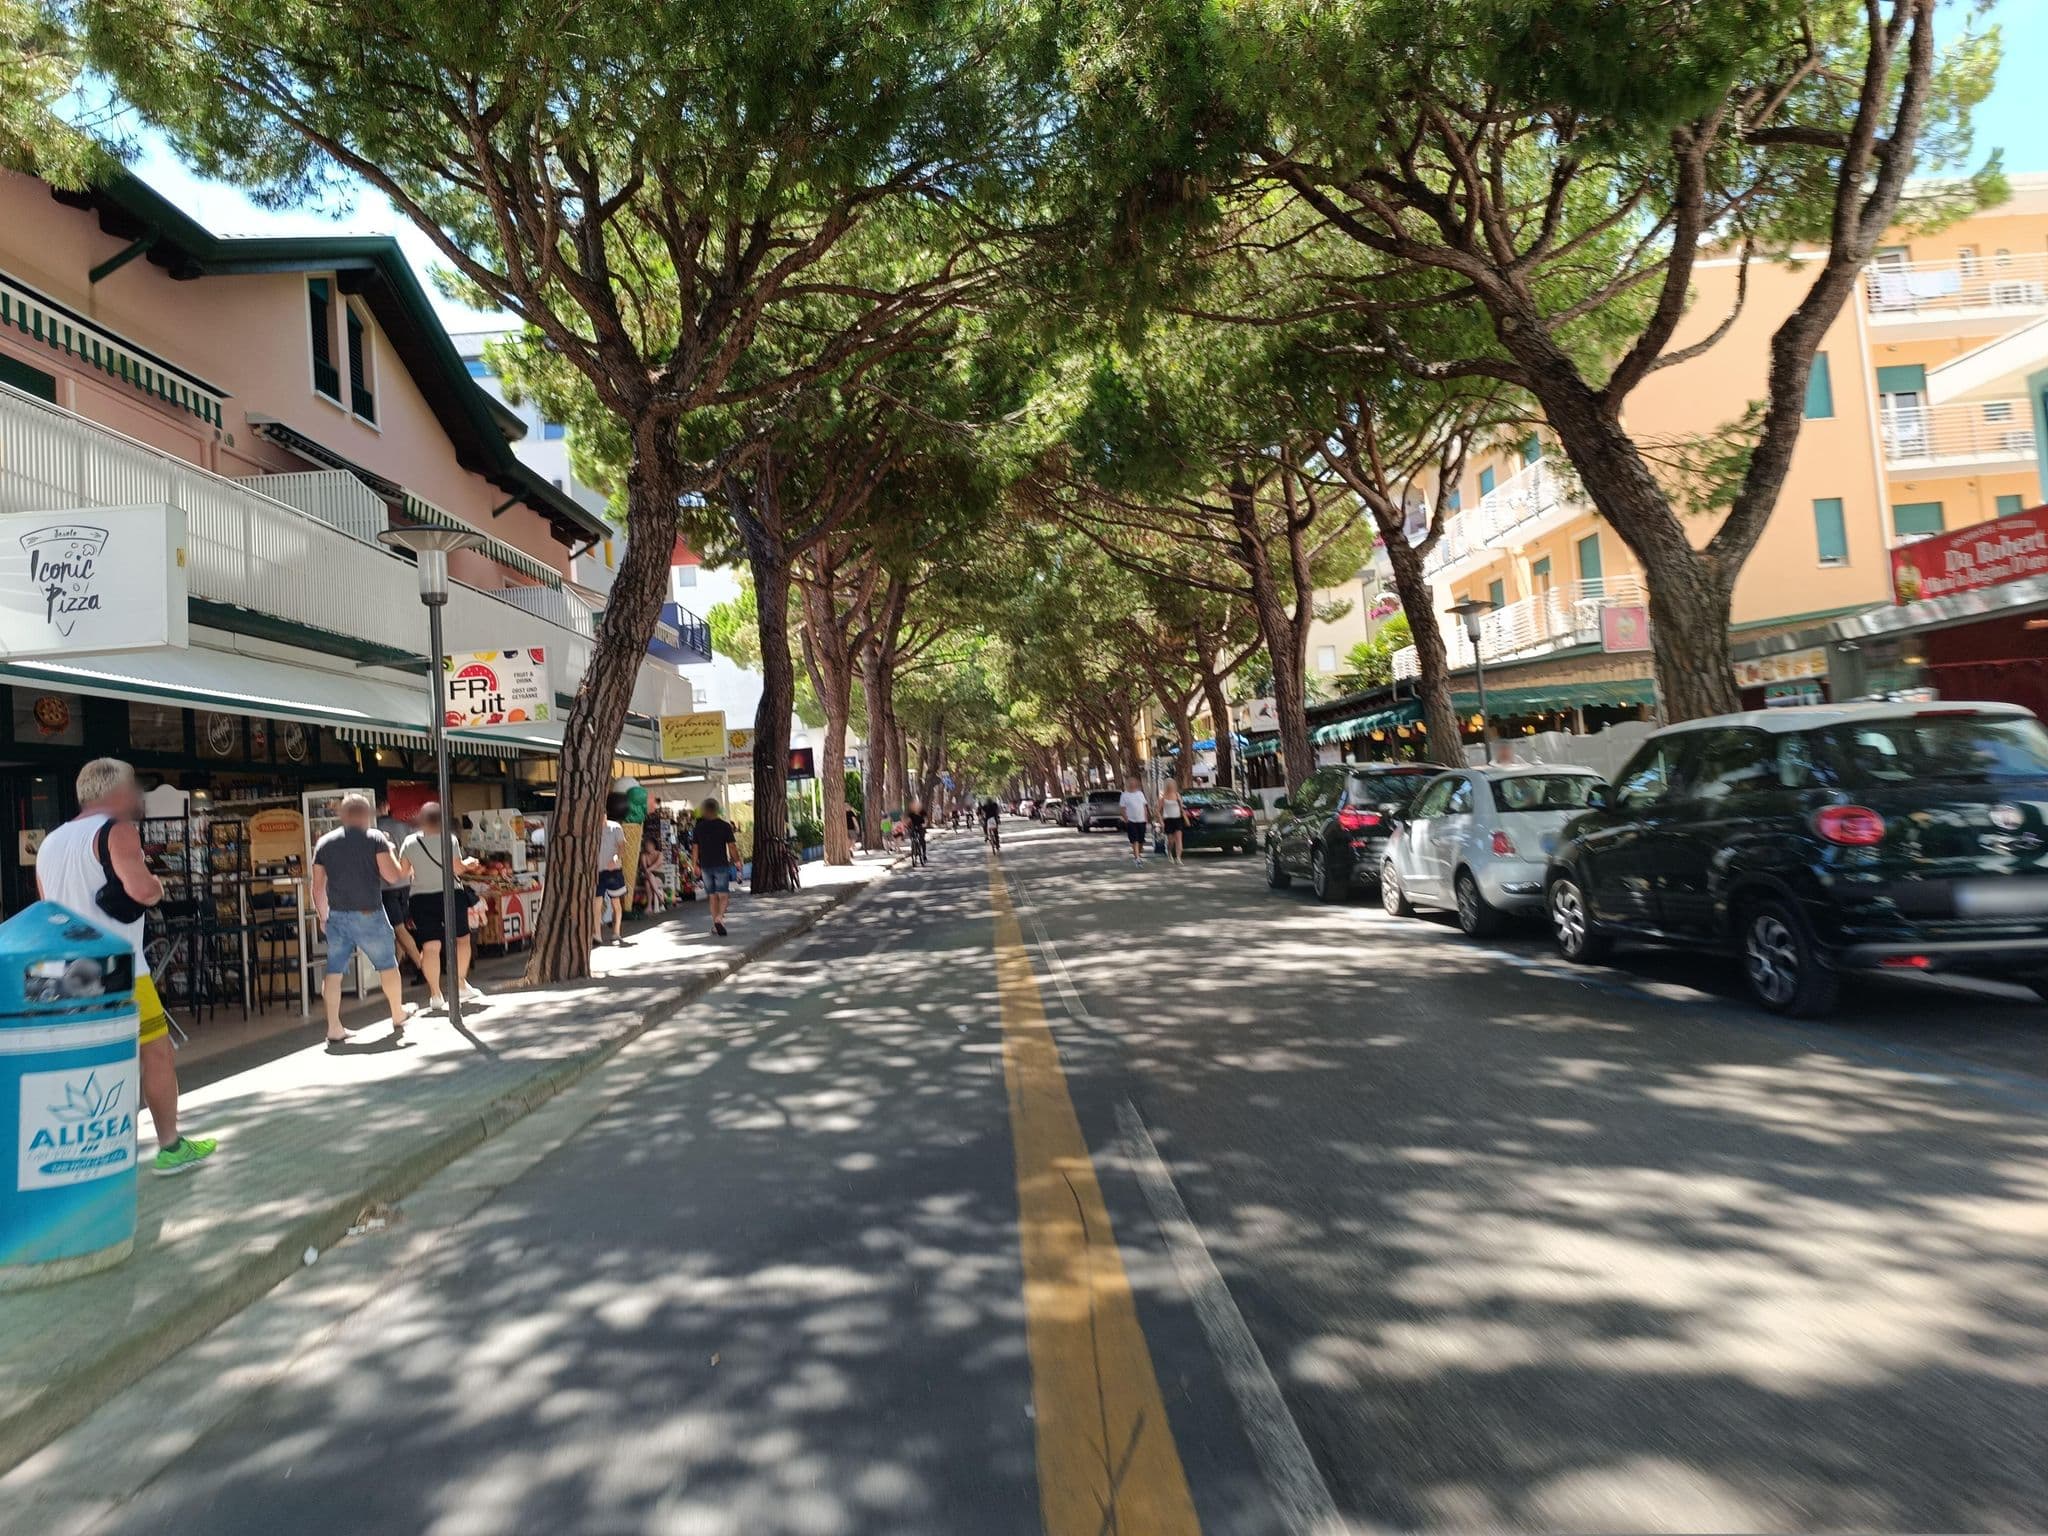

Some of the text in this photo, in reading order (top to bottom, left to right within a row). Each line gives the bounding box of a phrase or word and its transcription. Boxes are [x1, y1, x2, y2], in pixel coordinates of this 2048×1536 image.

[31, 549, 95, 583] Iconic
[45, 583, 101, 624] Pizza
[29, 1114, 131, 1150] ALISEA
